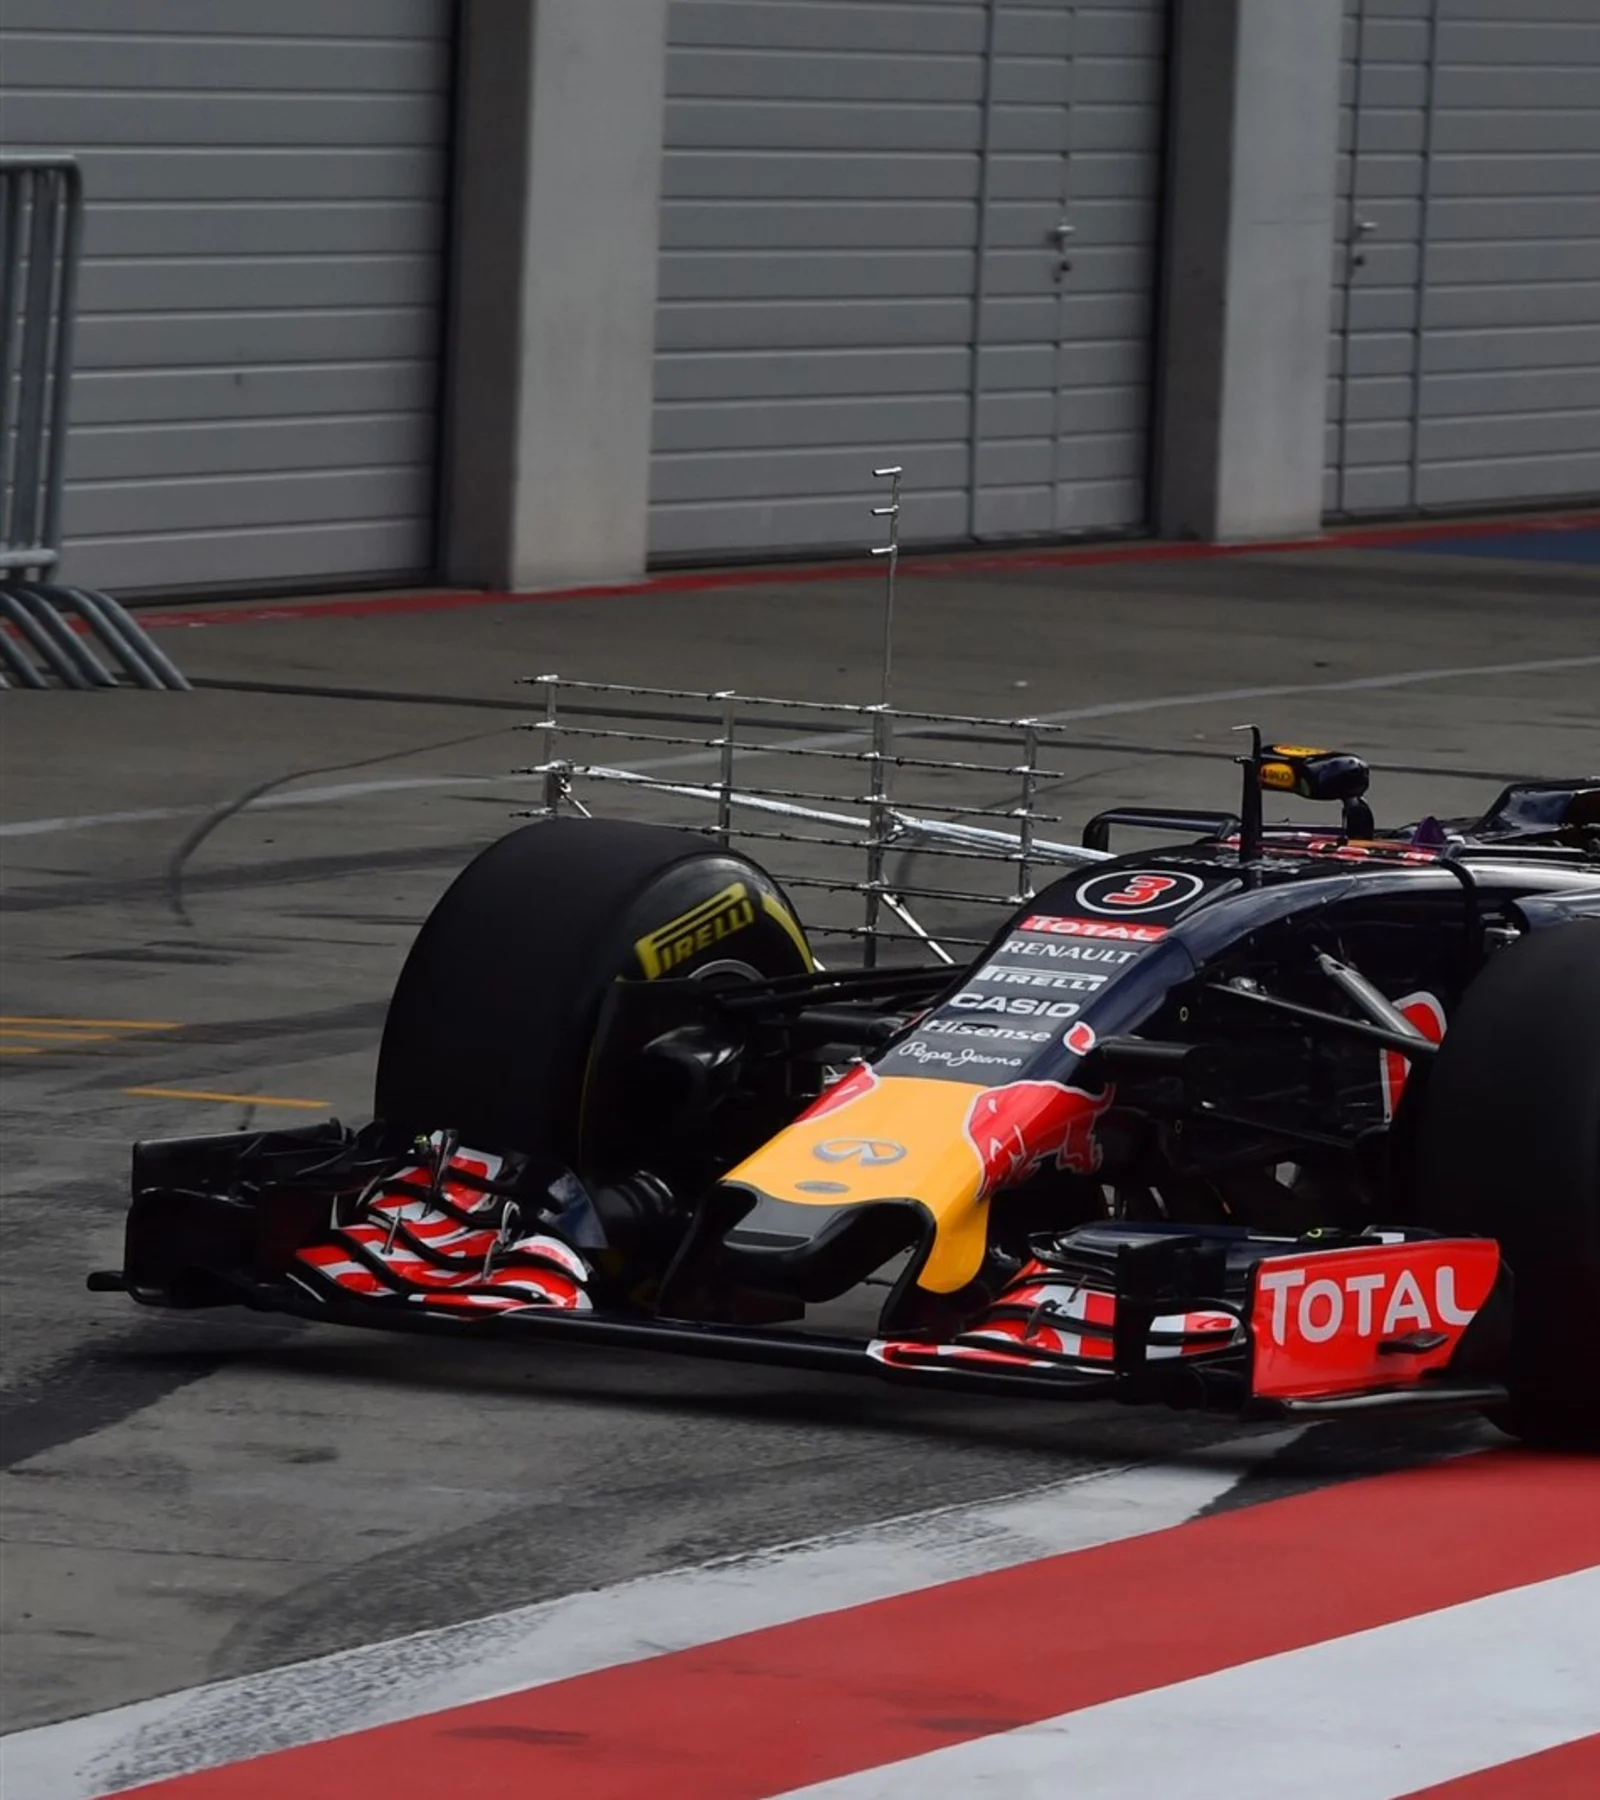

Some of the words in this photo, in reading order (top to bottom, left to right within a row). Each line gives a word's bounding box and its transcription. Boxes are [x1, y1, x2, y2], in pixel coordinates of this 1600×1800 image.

[1101, 874, 1179, 906] 3
[634, 882, 754, 982] PIRELLI
[1026, 915, 1164, 941] TOTAL
[1002, 941, 1140, 965] RENAULT
[976, 965, 1109, 992] PIRELLI
[949, 993, 1080, 1018] CASIO
[923, 1020, 1052, 1043] Hisense
[898, 1041, 951, 1063] Pepe
[949, 1048, 1023, 1067] Jeans
[1260, 1265, 1477, 1346] TOTAL
